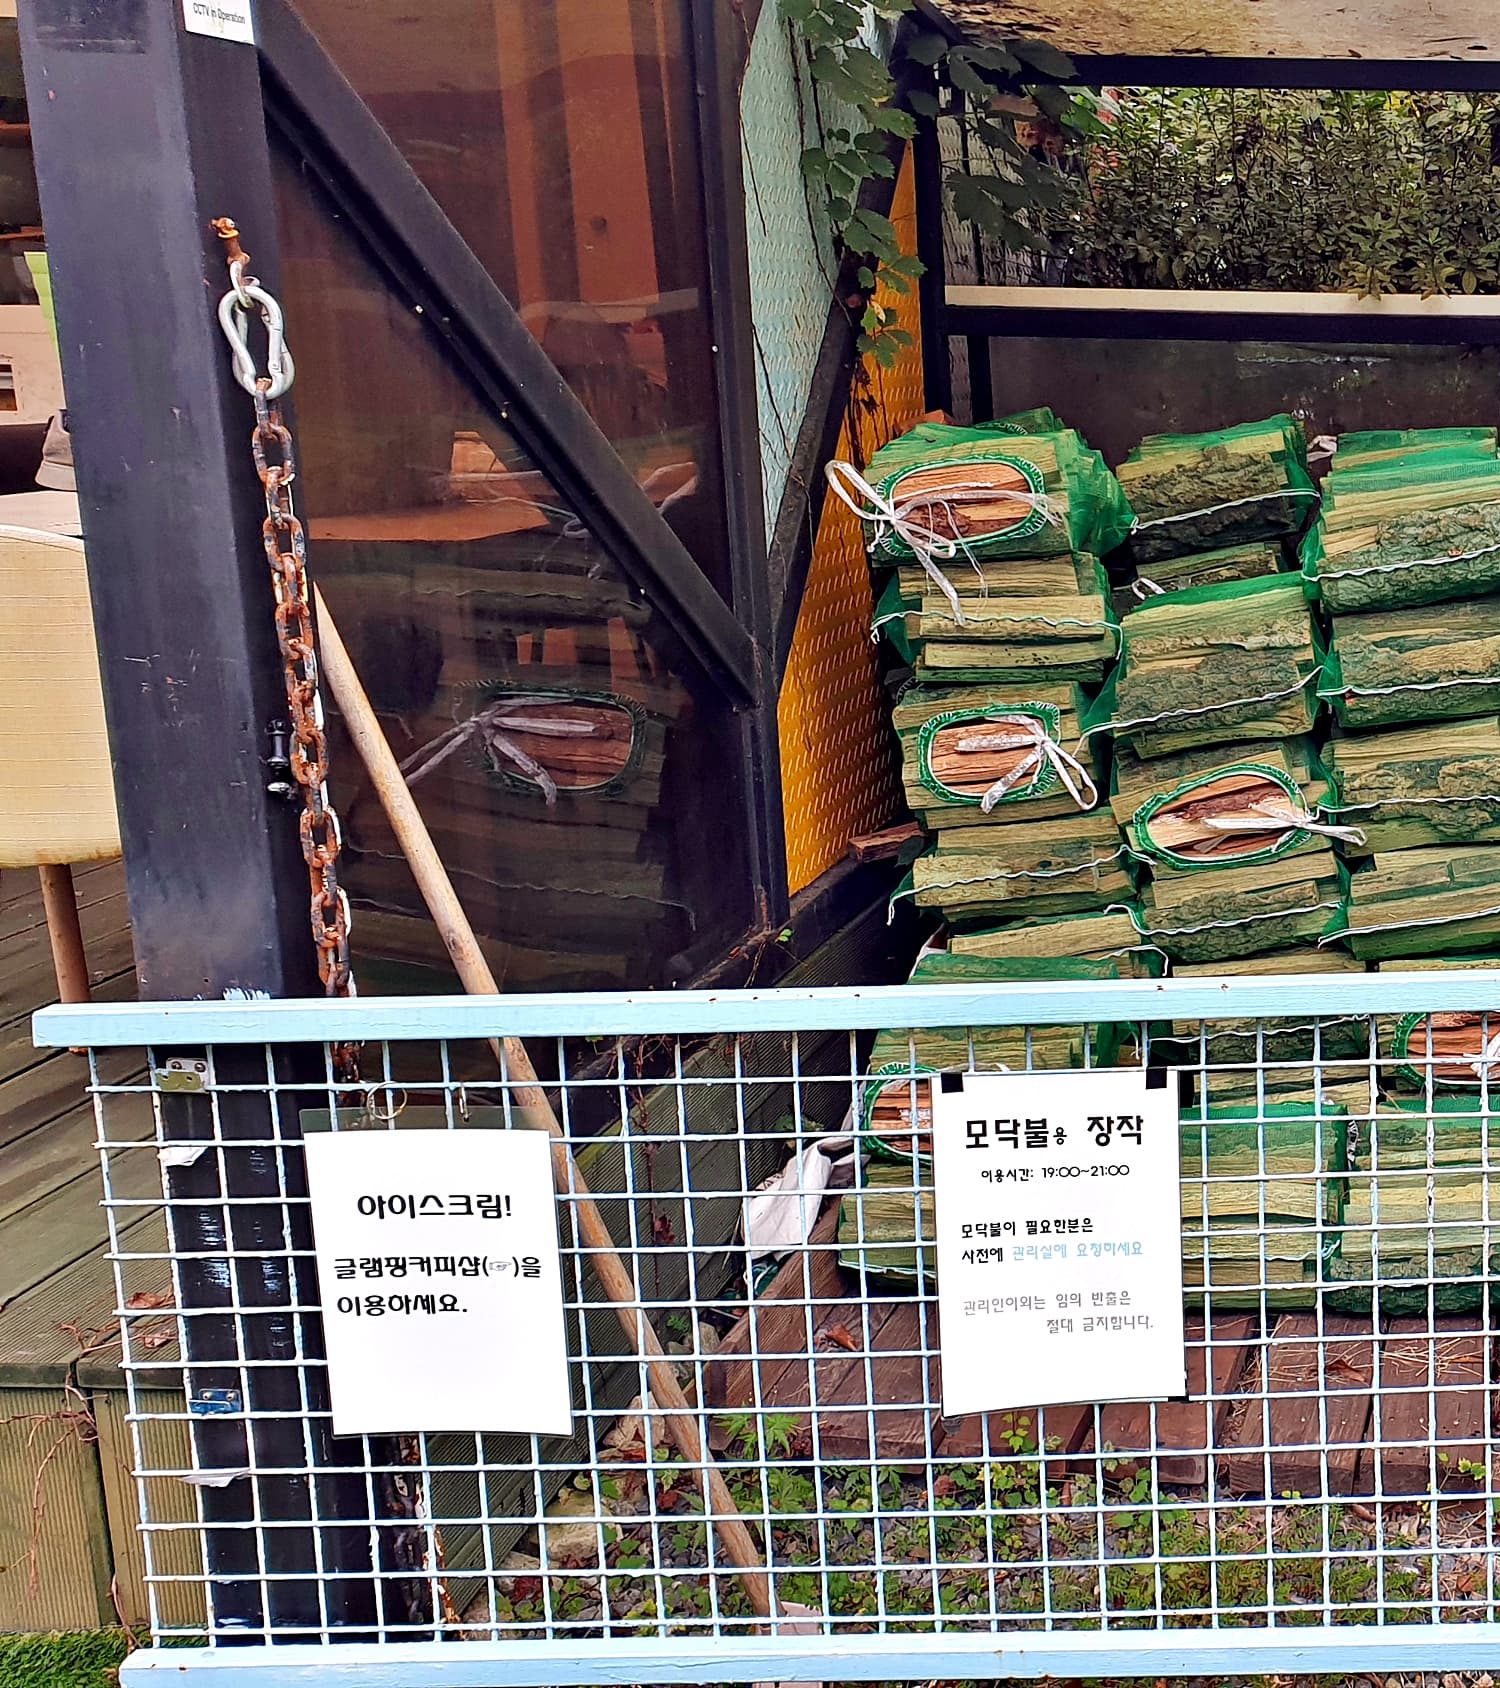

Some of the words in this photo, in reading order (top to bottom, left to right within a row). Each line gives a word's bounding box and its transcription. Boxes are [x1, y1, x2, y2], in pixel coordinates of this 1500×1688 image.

[193, 2, 210, 17] CCTV
[217, 8, 246, 24] Operation
[965, 1117, 1068, 1149] 모닥불용
[1086, 1115, 1144, 1147] 장작
[981, 1168, 1034, 1184] 이용시간:
[1041, 1164, 1130, 1179] 19:00~21:00
[357, 1193, 512, 1220] 아이스크림!
[961, 1220, 1016, 1239] 모닥불이
[1025, 1217, 1094, 1236] 필요한분은
[961, 1247, 1004, 1265] 사전에
[1012, 1243, 1068, 1262] 관리실에
[1076, 1240, 1144, 1258] 요청하세요
[336, 1293, 468, 1317] 이용하세요.
[963, 1295, 1047, 1316] 관리인이외는
[1055, 1292, 1082, 1309] 임의
[1091, 1290, 1132, 1307] 반출은
[1046, 1318, 1074, 1335] 절대
[1082, 1314, 1154, 1332] 금지합니다.
